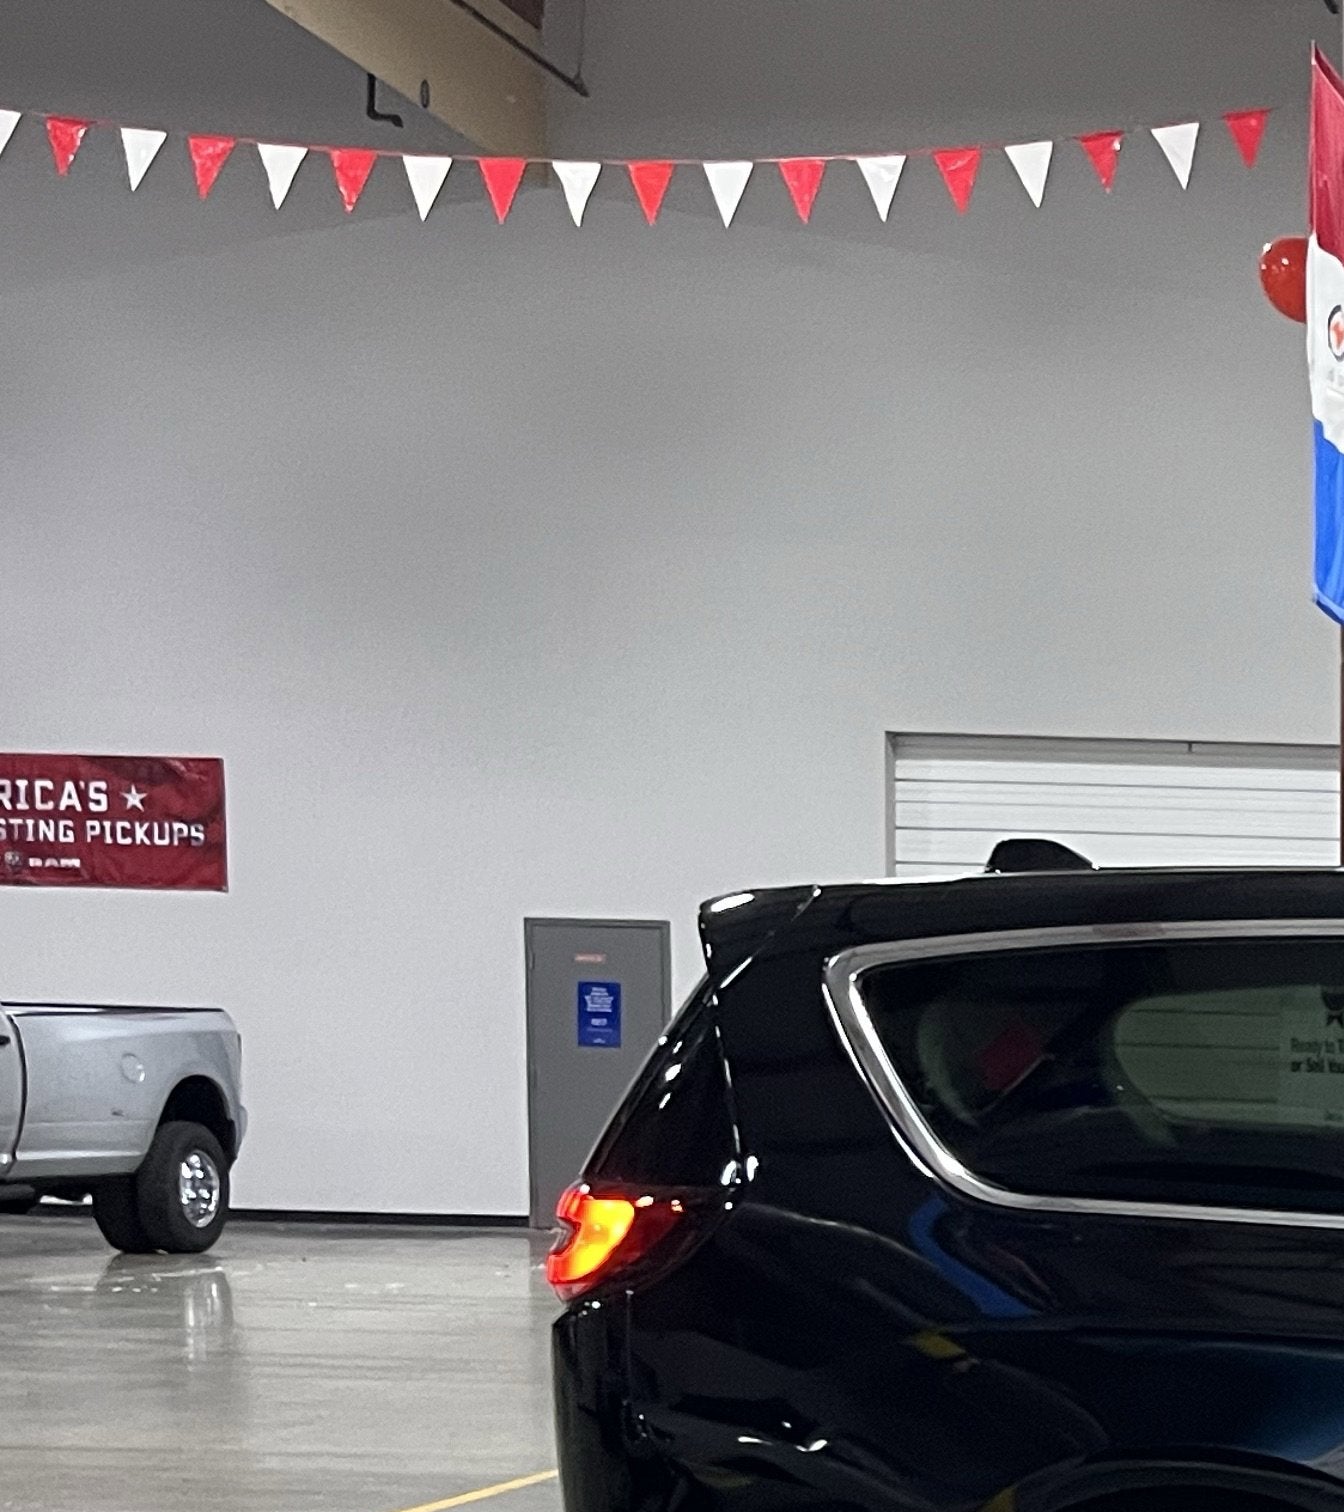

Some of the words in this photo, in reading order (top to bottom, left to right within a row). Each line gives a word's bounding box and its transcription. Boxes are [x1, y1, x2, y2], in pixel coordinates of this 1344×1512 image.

[85, 819, 205, 847] PICKUPS
[1291, 1038, 1321, 1057] Ready
[1291, 1061, 1302, 1073] or
[1306, 1057, 1325, 1073] Sell
